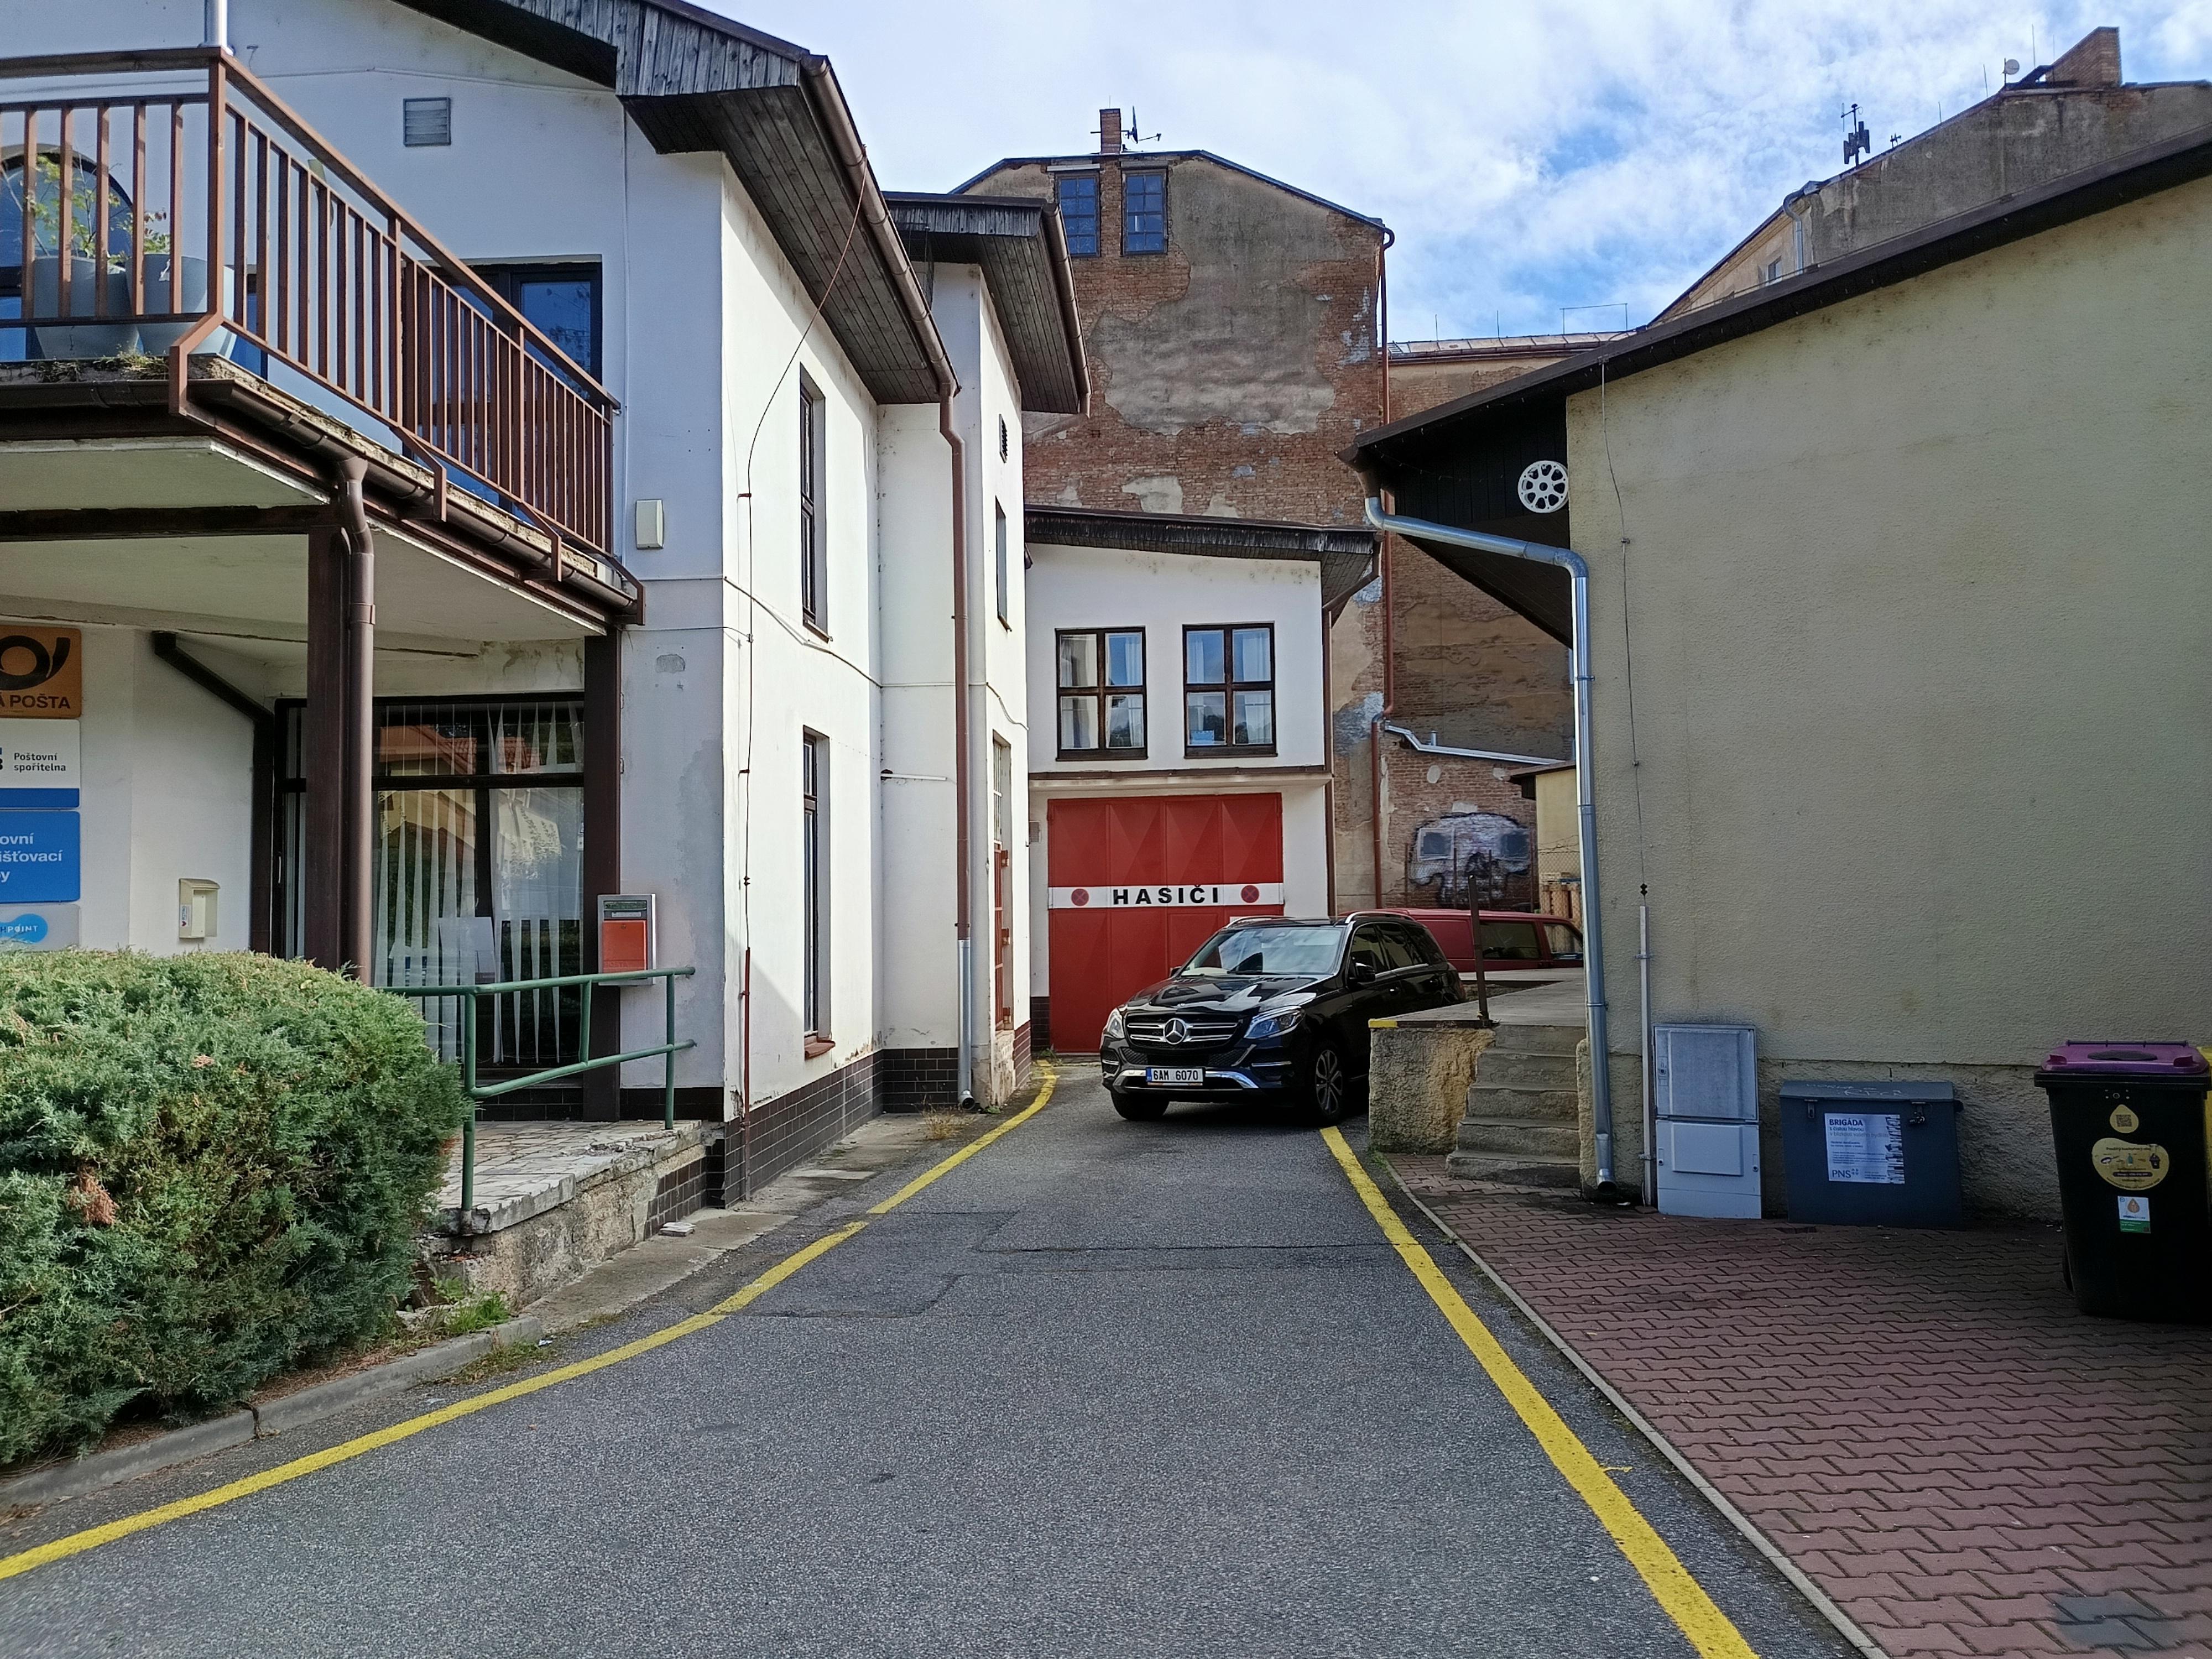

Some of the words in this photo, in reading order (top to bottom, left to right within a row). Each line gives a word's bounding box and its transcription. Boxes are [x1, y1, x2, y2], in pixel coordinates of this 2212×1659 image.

[10, 693, 71, 708] POŠTA
[14, 752, 58, 761] Poštovní
[14, 763, 66, 773] spořitelna
[1113, 884, 1218, 905] HASIČI
[1154, 1070, 1169, 1080] 6AM
[1176, 1070, 1199, 1081] 6070
[1829, 1118, 1863, 1126] BRIGÁDA
[1832, 1170, 1851, 1178] PNS
